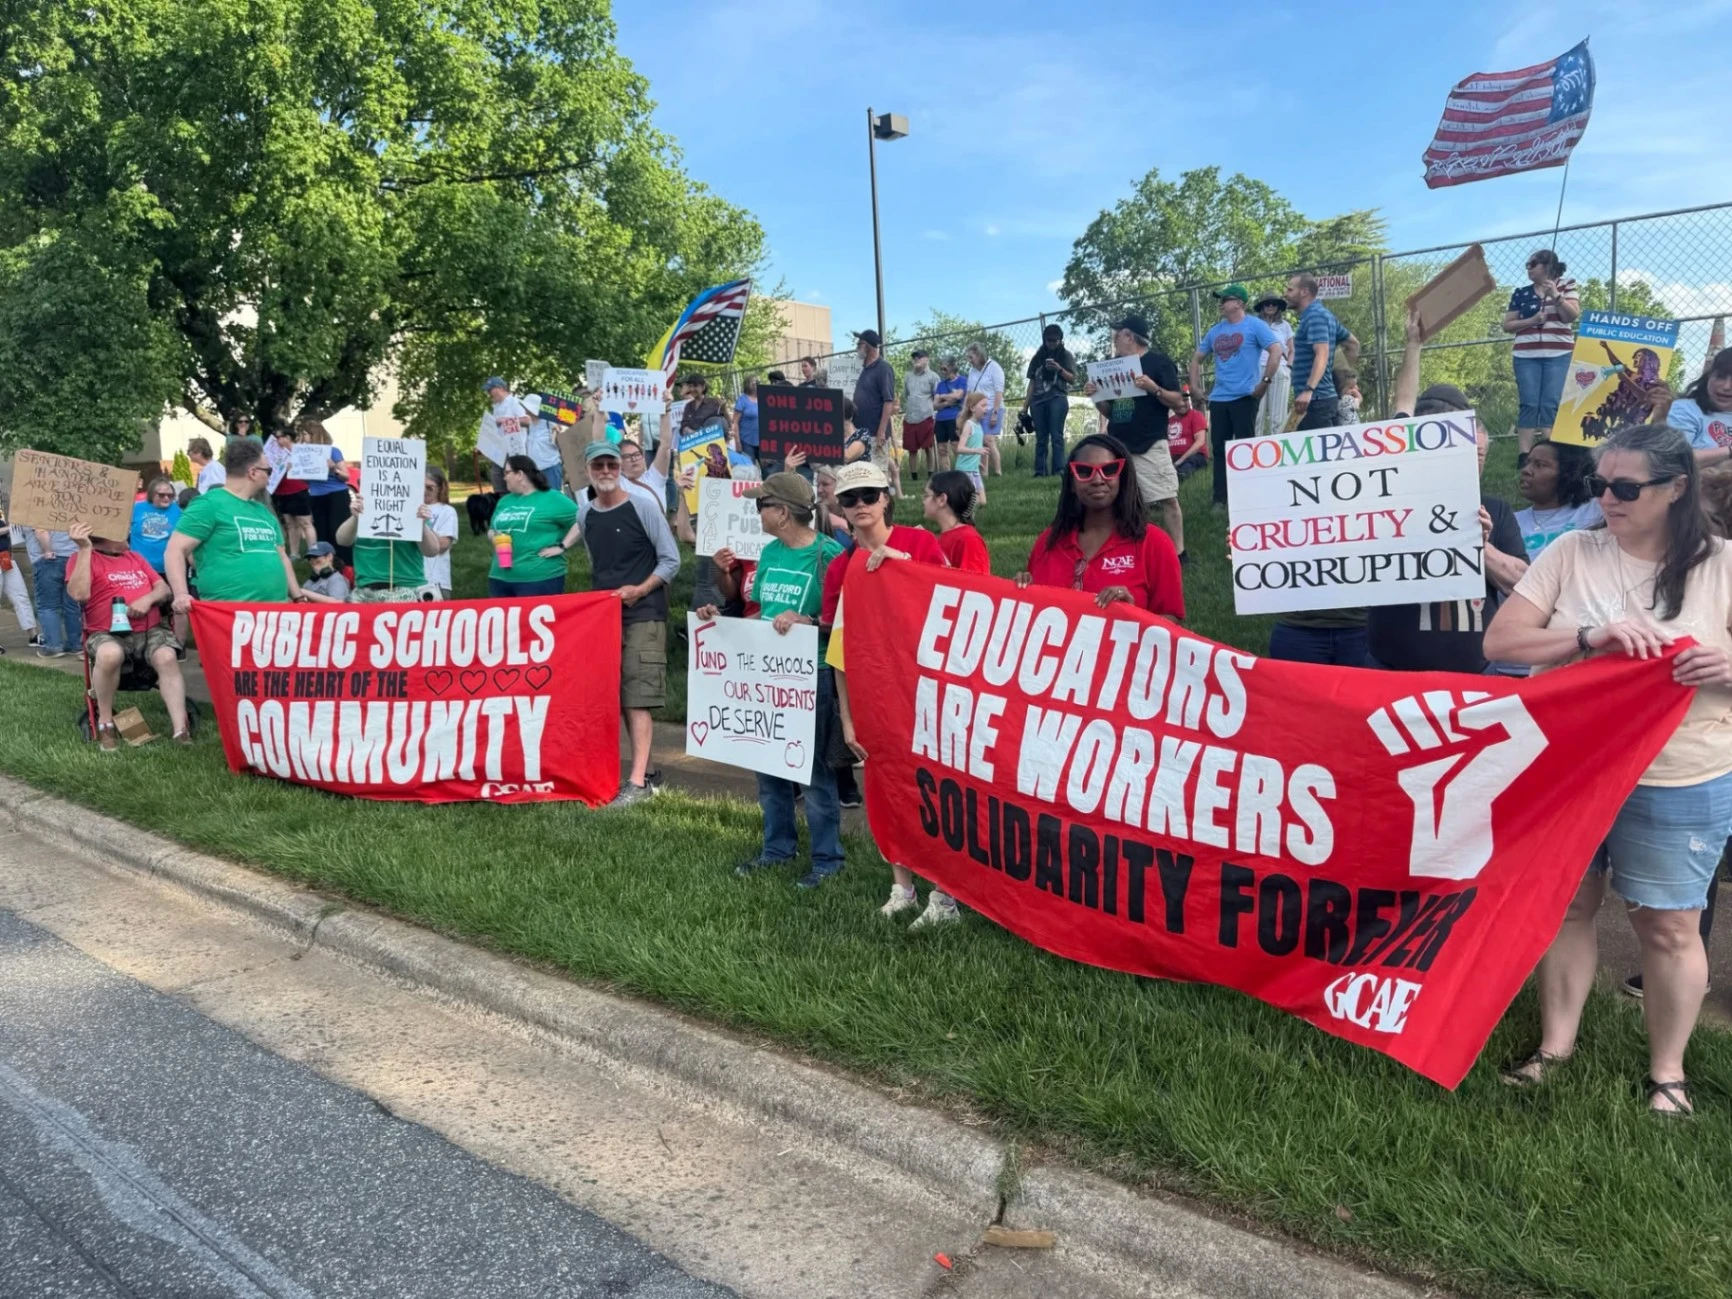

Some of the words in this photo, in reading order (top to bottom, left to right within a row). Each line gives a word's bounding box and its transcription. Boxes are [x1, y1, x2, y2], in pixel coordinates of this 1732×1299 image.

[1316, 276, 1351, 288] ATIONAL
[1590, 312, 1640, 328] HANDS
[1645, 320, 1674, 333] OFF
[1586, 326, 1617, 338] PUBLIC
[1618, 330, 1670, 344] EDUCATION
[766, 394, 797, 410] ONE
[805, 397, 833, 412] JOB
[768, 419, 833, 435] SHOULD
[377, 440, 408, 455] EQUAL
[760, 439, 778, 453] BE
[1227, 416, 1476, 471] COMPASSION
[367, 455, 417, 469] EDUCATION
[379, 469, 388, 481] IS
[393, 471, 401, 483] A
[1287, 467, 1399, 506] NOT
[371, 483, 410, 498] HUMAN
[375, 499, 406, 512] RIGHT
[743, 500, 756, 515] fo
[728, 513, 764, 534] PUB
[1231, 508, 1413, 551] CRUELTY
[1428, 504, 1459, 534] &
[1101, 555, 1135, 569] NCAE
[1234, 546, 1484, 591] CORRUPTION
[231, 610, 360, 670] PUBLIC
[370, 604, 556, 669] SCHOOLS
[737, 652, 757, 671] THE
[762, 655, 814, 675] SCHOOLS
[916, 584, 1258, 739] EDUCATORS
[234, 671, 259, 697] ARE
[262, 670, 290, 698] THE
[294, 670, 344, 698] HEART
[350, 671, 371, 697] OF
[377, 671, 408, 698] THE
[724, 680, 752, 702] OUR
[755, 683, 816, 711] STUDENTS
[709, 705, 786, 741] DESERVE
[237, 695, 552, 785] COMMUNITY
[911, 675, 1008, 783] ARE
[1016, 704, 1337, 866] WORKERS
[915, 767, 1195, 935] SOLIDARITY
[1218, 862, 1478, 973] FOREVER
[1324, 972, 1422, 1034] GCAE
